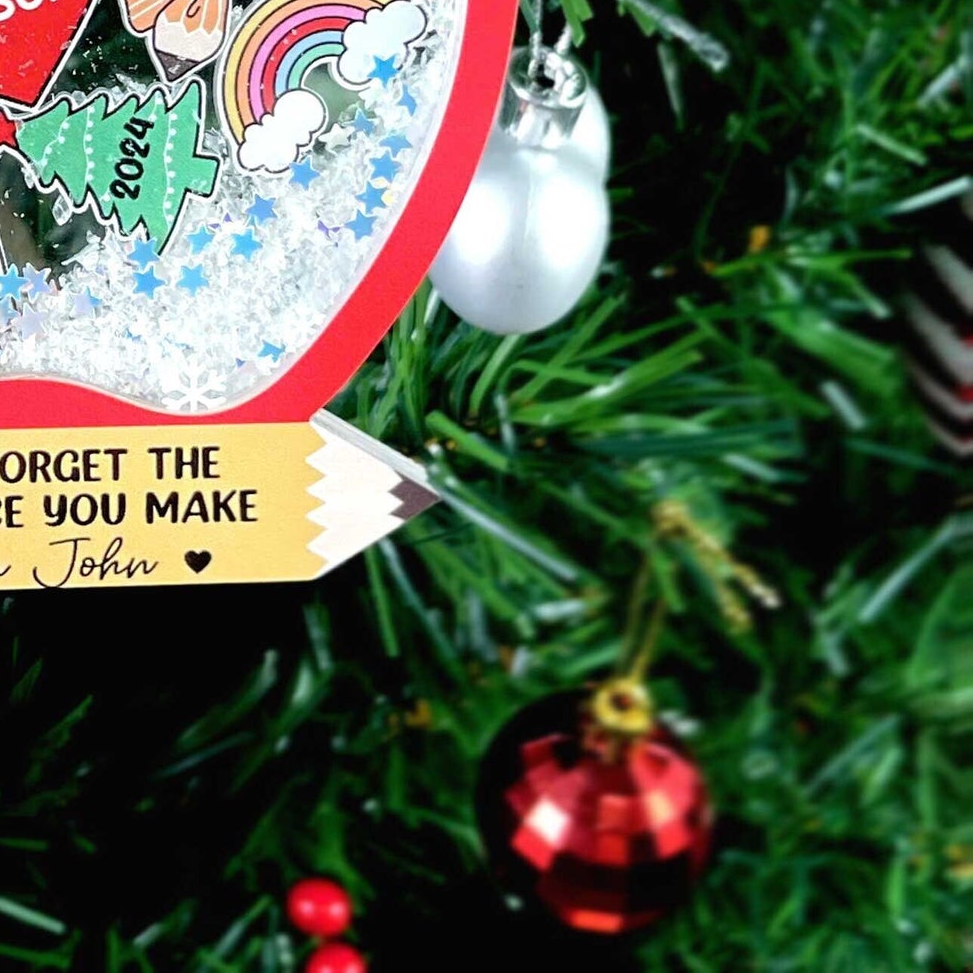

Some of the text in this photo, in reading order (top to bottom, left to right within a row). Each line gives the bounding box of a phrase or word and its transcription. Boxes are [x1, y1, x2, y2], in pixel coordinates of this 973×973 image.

[109, 117, 156, 201] 2024
[148, 446, 221, 480] THE
[43, 492, 127, 527] YOU
[145, 489, 258, 524] MAKE
[33, 537, 159, 589] John
